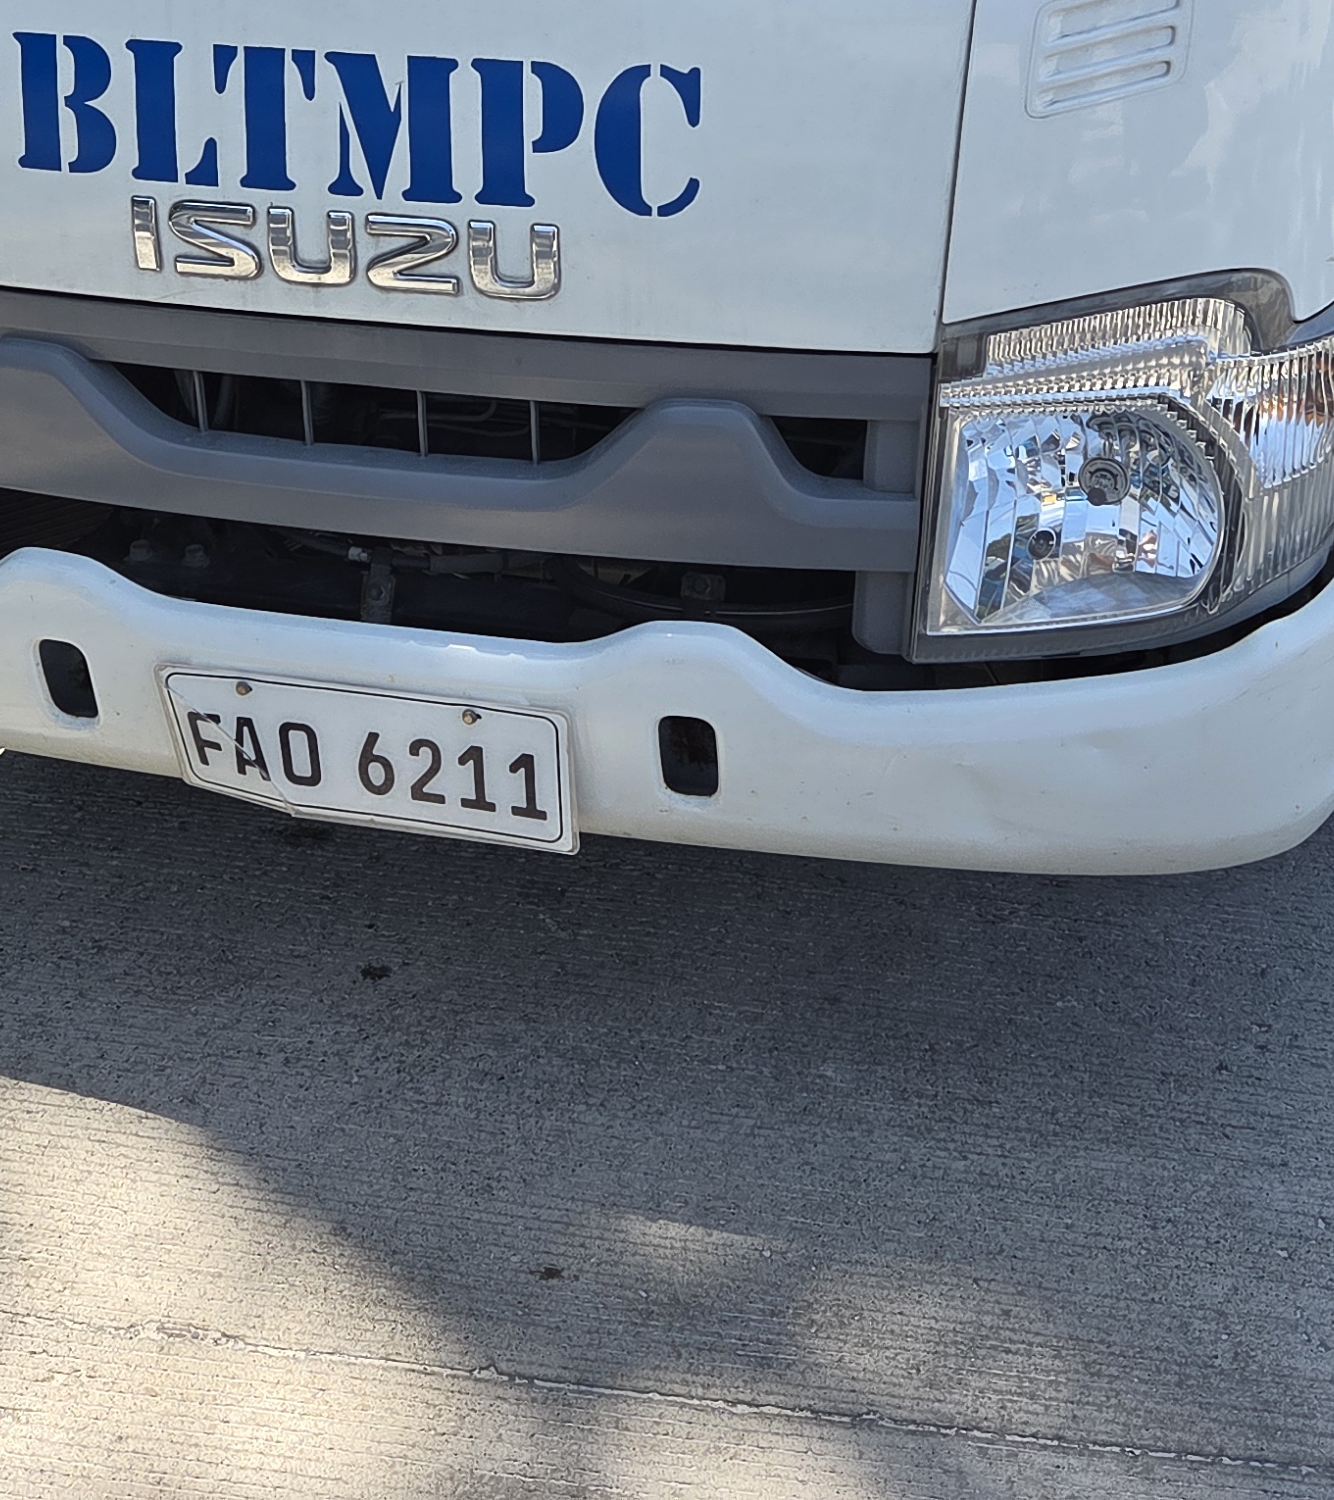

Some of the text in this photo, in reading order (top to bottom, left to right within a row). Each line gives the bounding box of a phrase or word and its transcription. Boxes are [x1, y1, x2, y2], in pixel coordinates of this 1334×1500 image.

[12, 31, 701, 218] BLTMPC
[130, 195, 561, 301] ISUZU
[186, 711, 548, 821] FAO 6211
